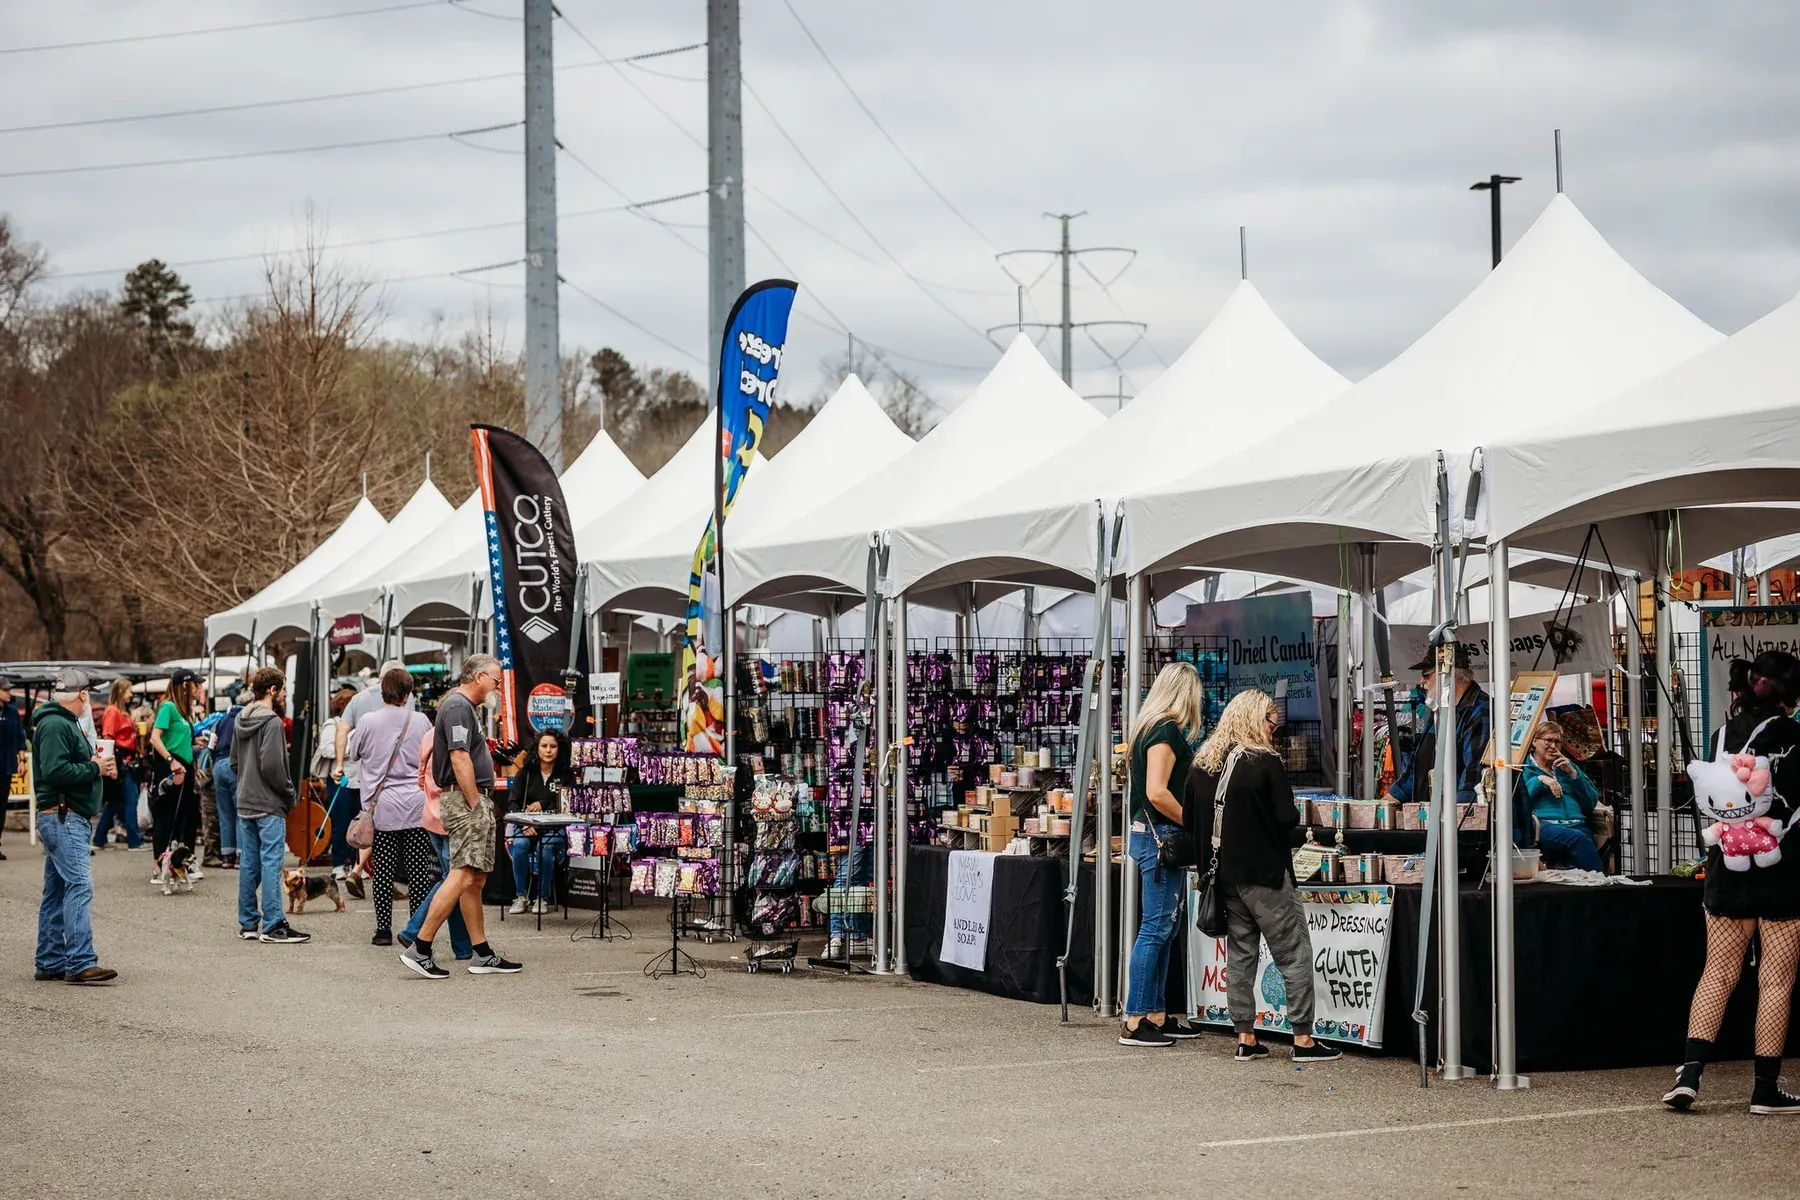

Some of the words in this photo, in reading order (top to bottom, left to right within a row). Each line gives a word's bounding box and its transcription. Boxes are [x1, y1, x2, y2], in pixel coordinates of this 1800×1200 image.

[542, 495, 553, 530] Cutlery
[546, 532, 557, 558] Finest
[550, 559, 561, 593] World's
[554, 595, 563, 613] The
[1232, 636, 1267, 666] Dried
[1270, 632, 1316, 668] Candy
[1510, 634, 1545, 654] aps
[1743, 634, 1800, 661] NATURA
[1229, 674, 1258, 689] eychains,
[1259, 671, 1280, 686] Wood
[1305, 685, 1313, 698] &
[955, 886, 977, 903] LOVE
[978, 923, 984, 933] &
[1307, 912, 1328, 931] AND
[1216, 937, 1228, 962] N
[1201, 965, 1229, 992] MS
